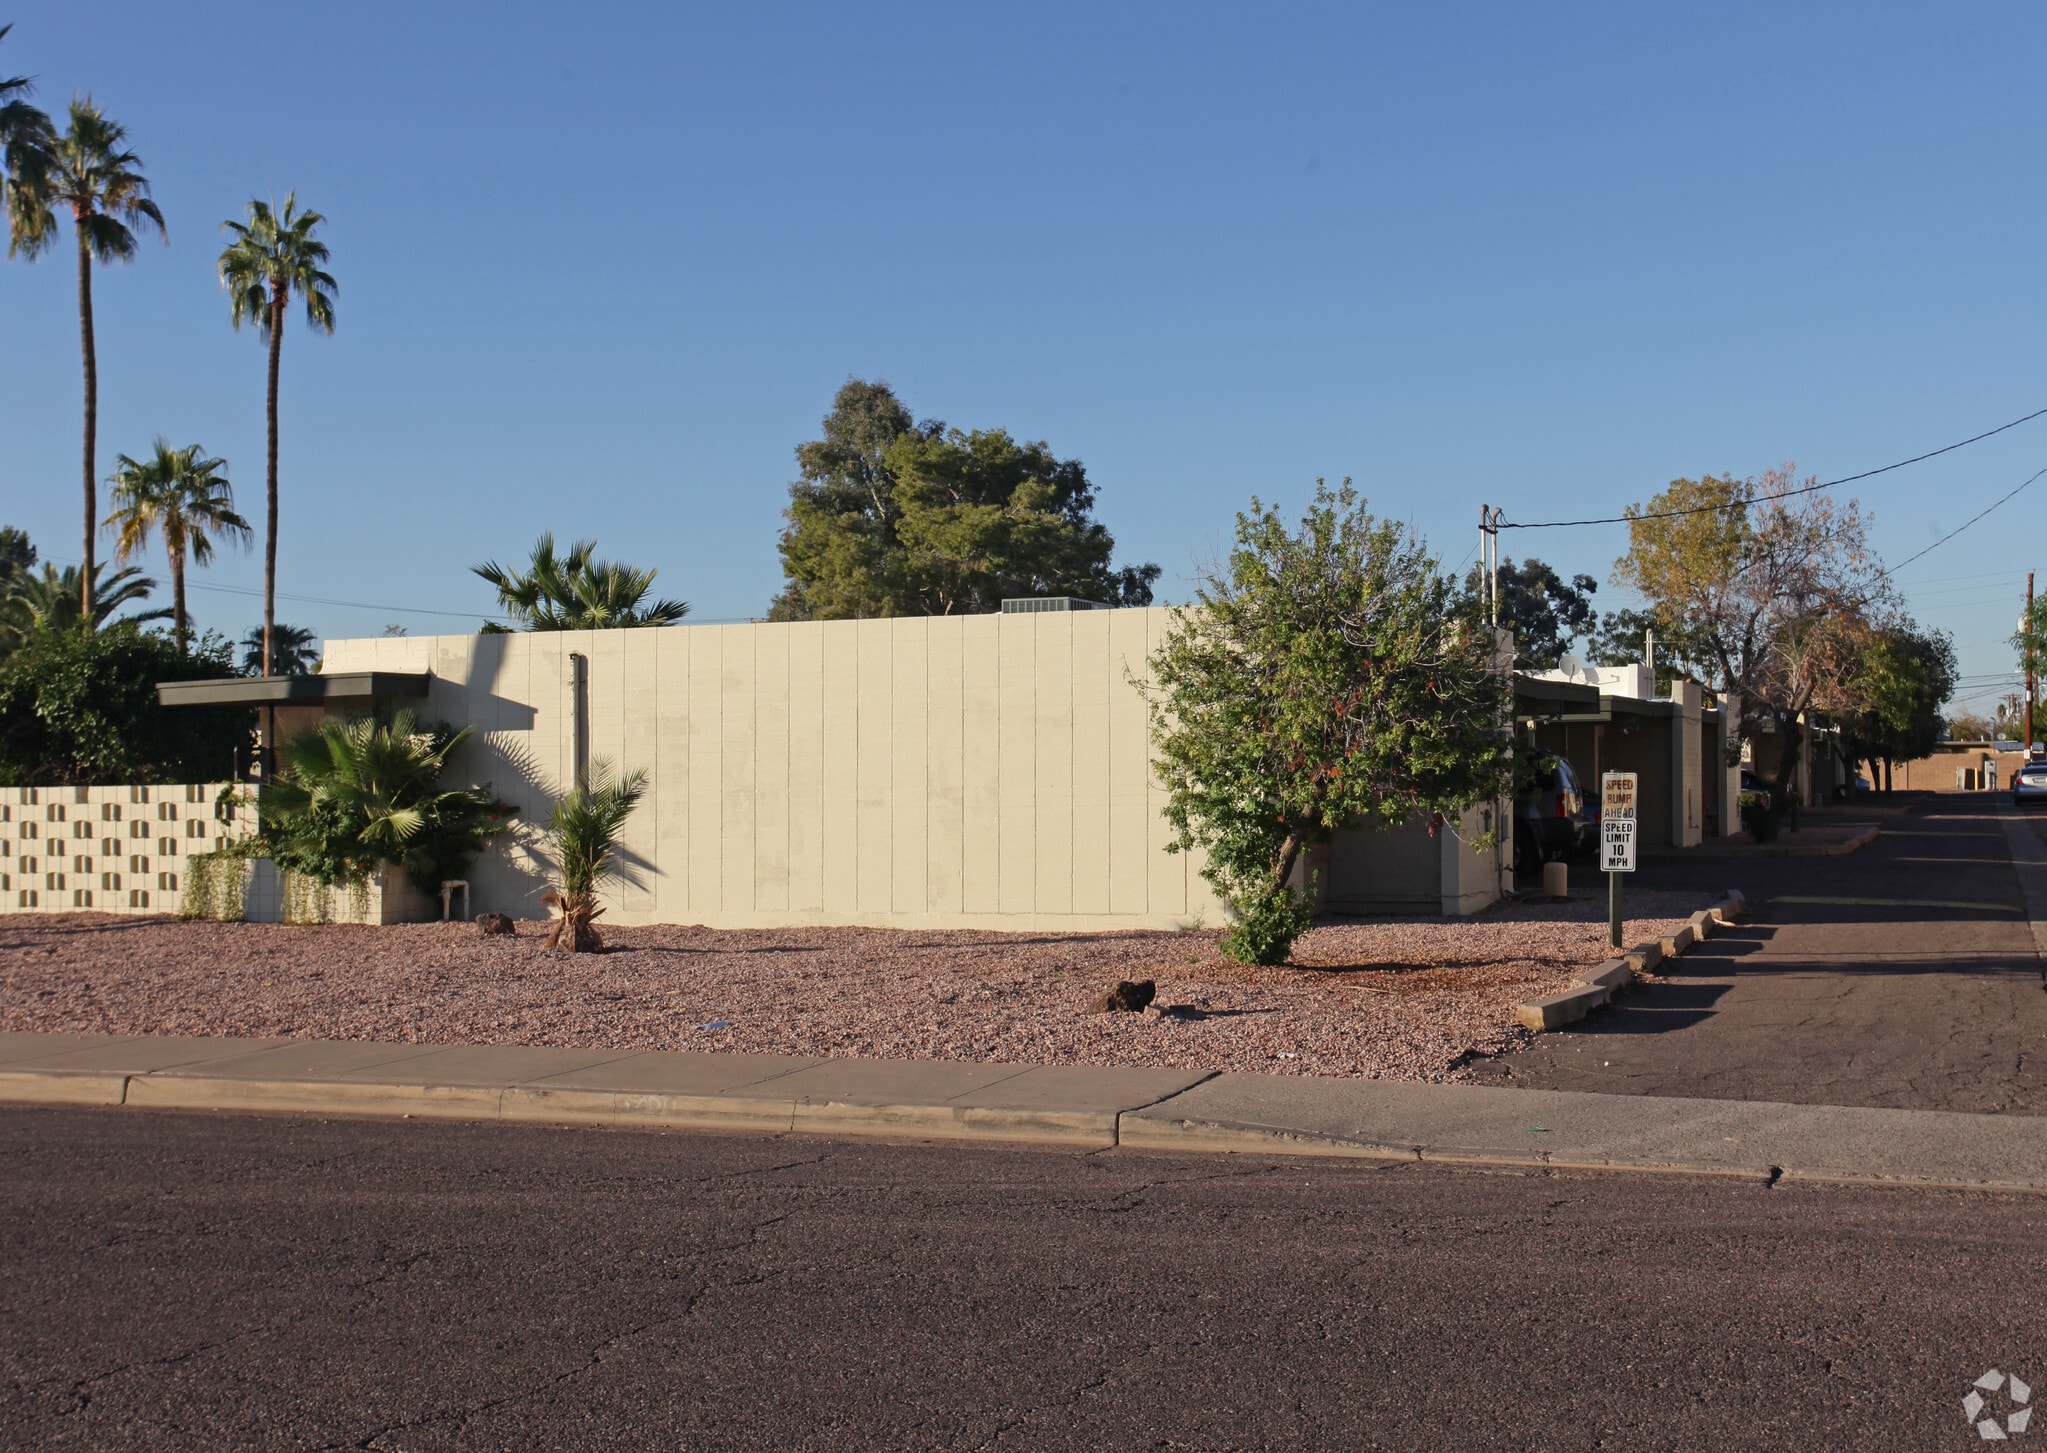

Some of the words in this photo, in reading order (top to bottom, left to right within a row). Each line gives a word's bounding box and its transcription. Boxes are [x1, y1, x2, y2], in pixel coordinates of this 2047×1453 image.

[1606, 780, 1633, 790] SPEED
[1607, 794, 1631, 804] BUMP
[1605, 808, 1633, 818] AHEAD
[1605, 823, 1632, 832] SPEED
[1606, 834, 1630, 843] LIMIT
[1613, 845, 1624, 856] 10
[1608, 858, 1627, 867] MPH
